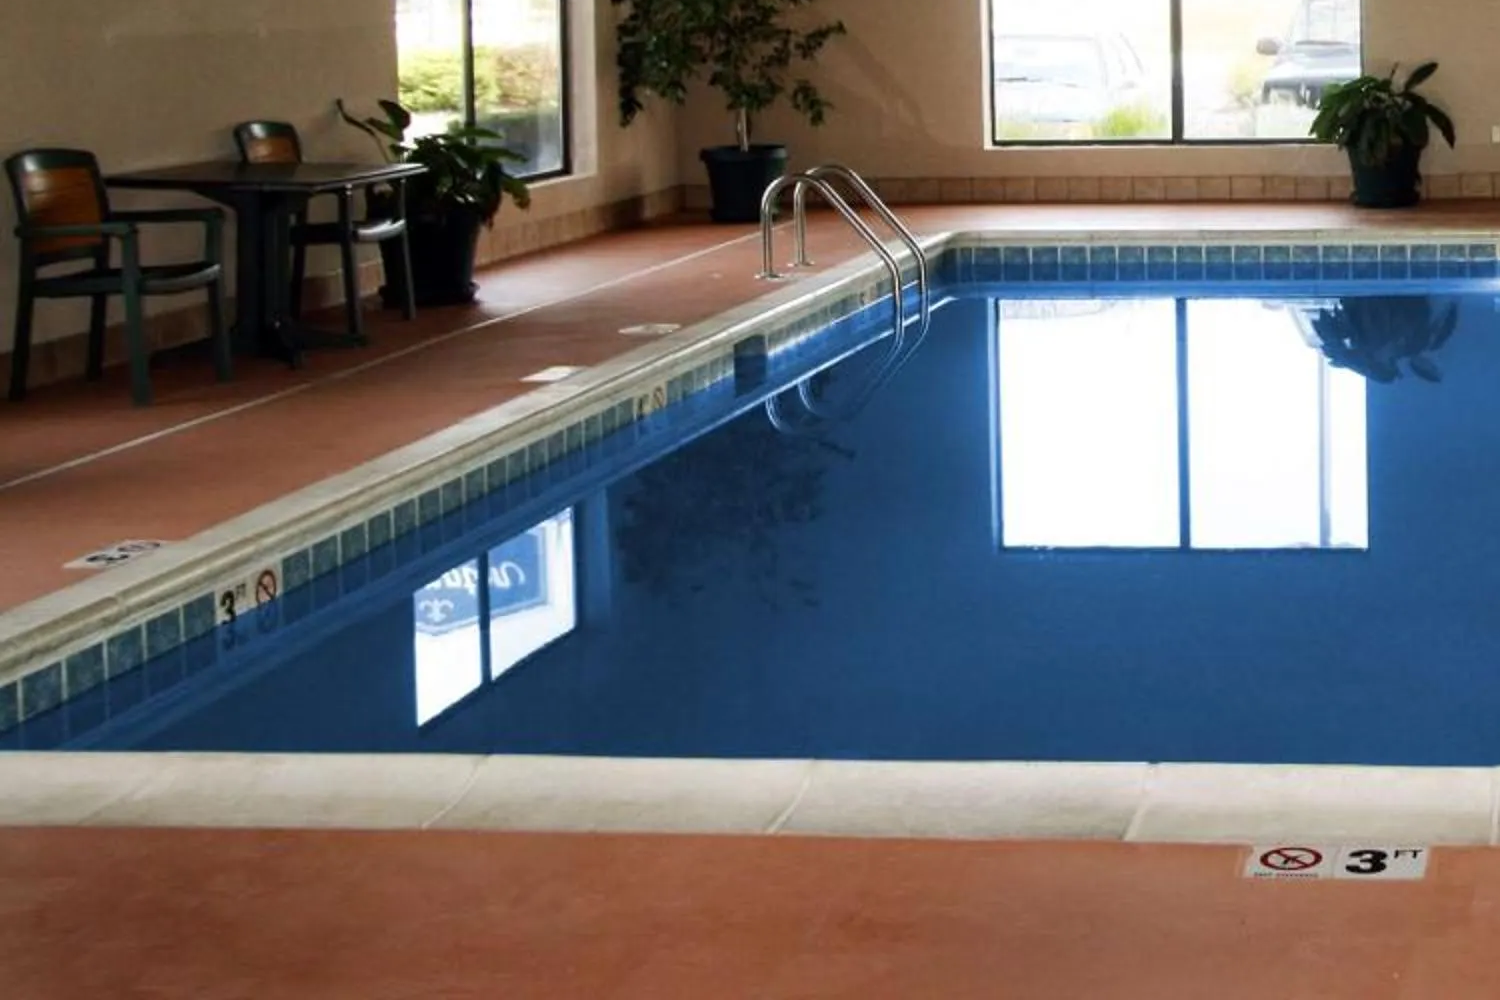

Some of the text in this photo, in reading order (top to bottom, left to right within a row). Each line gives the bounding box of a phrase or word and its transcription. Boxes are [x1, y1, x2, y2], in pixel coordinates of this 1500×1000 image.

[220, 590, 236, 625] 3
[1345, 849, 1422, 875] 3 FT
